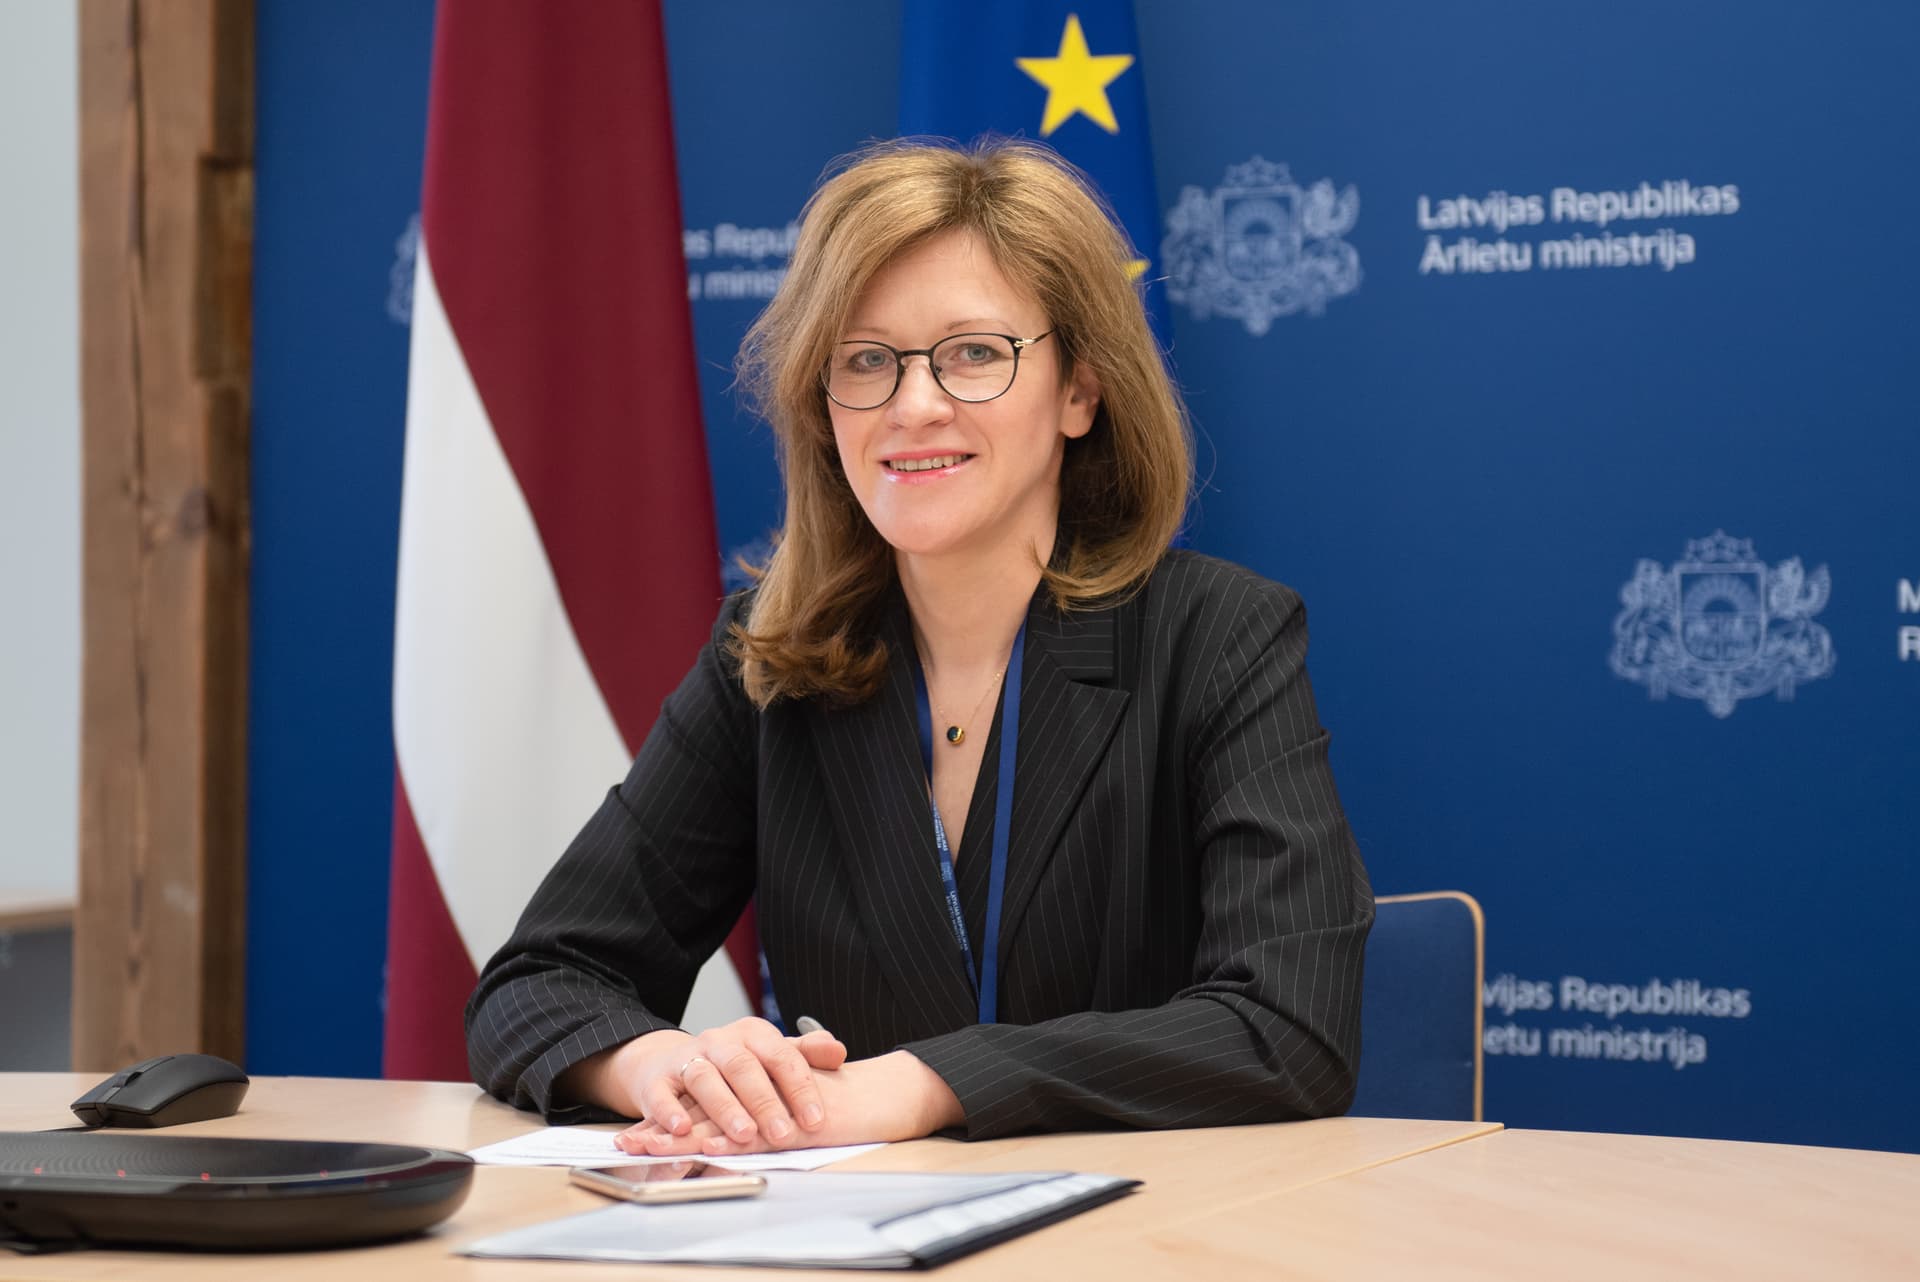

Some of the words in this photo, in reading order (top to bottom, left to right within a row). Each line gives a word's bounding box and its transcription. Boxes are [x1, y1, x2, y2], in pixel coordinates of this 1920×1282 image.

[1418, 191, 1545, 232] Latvijas
[1552, 180, 1740, 226] Republikas
[1418, 234, 1532, 275] Ārlietu
[1539, 228, 1696, 272] ministrija
[1559, 975, 1751, 1020] Republikas
[1548, 1022, 1707, 1070] ministrija
